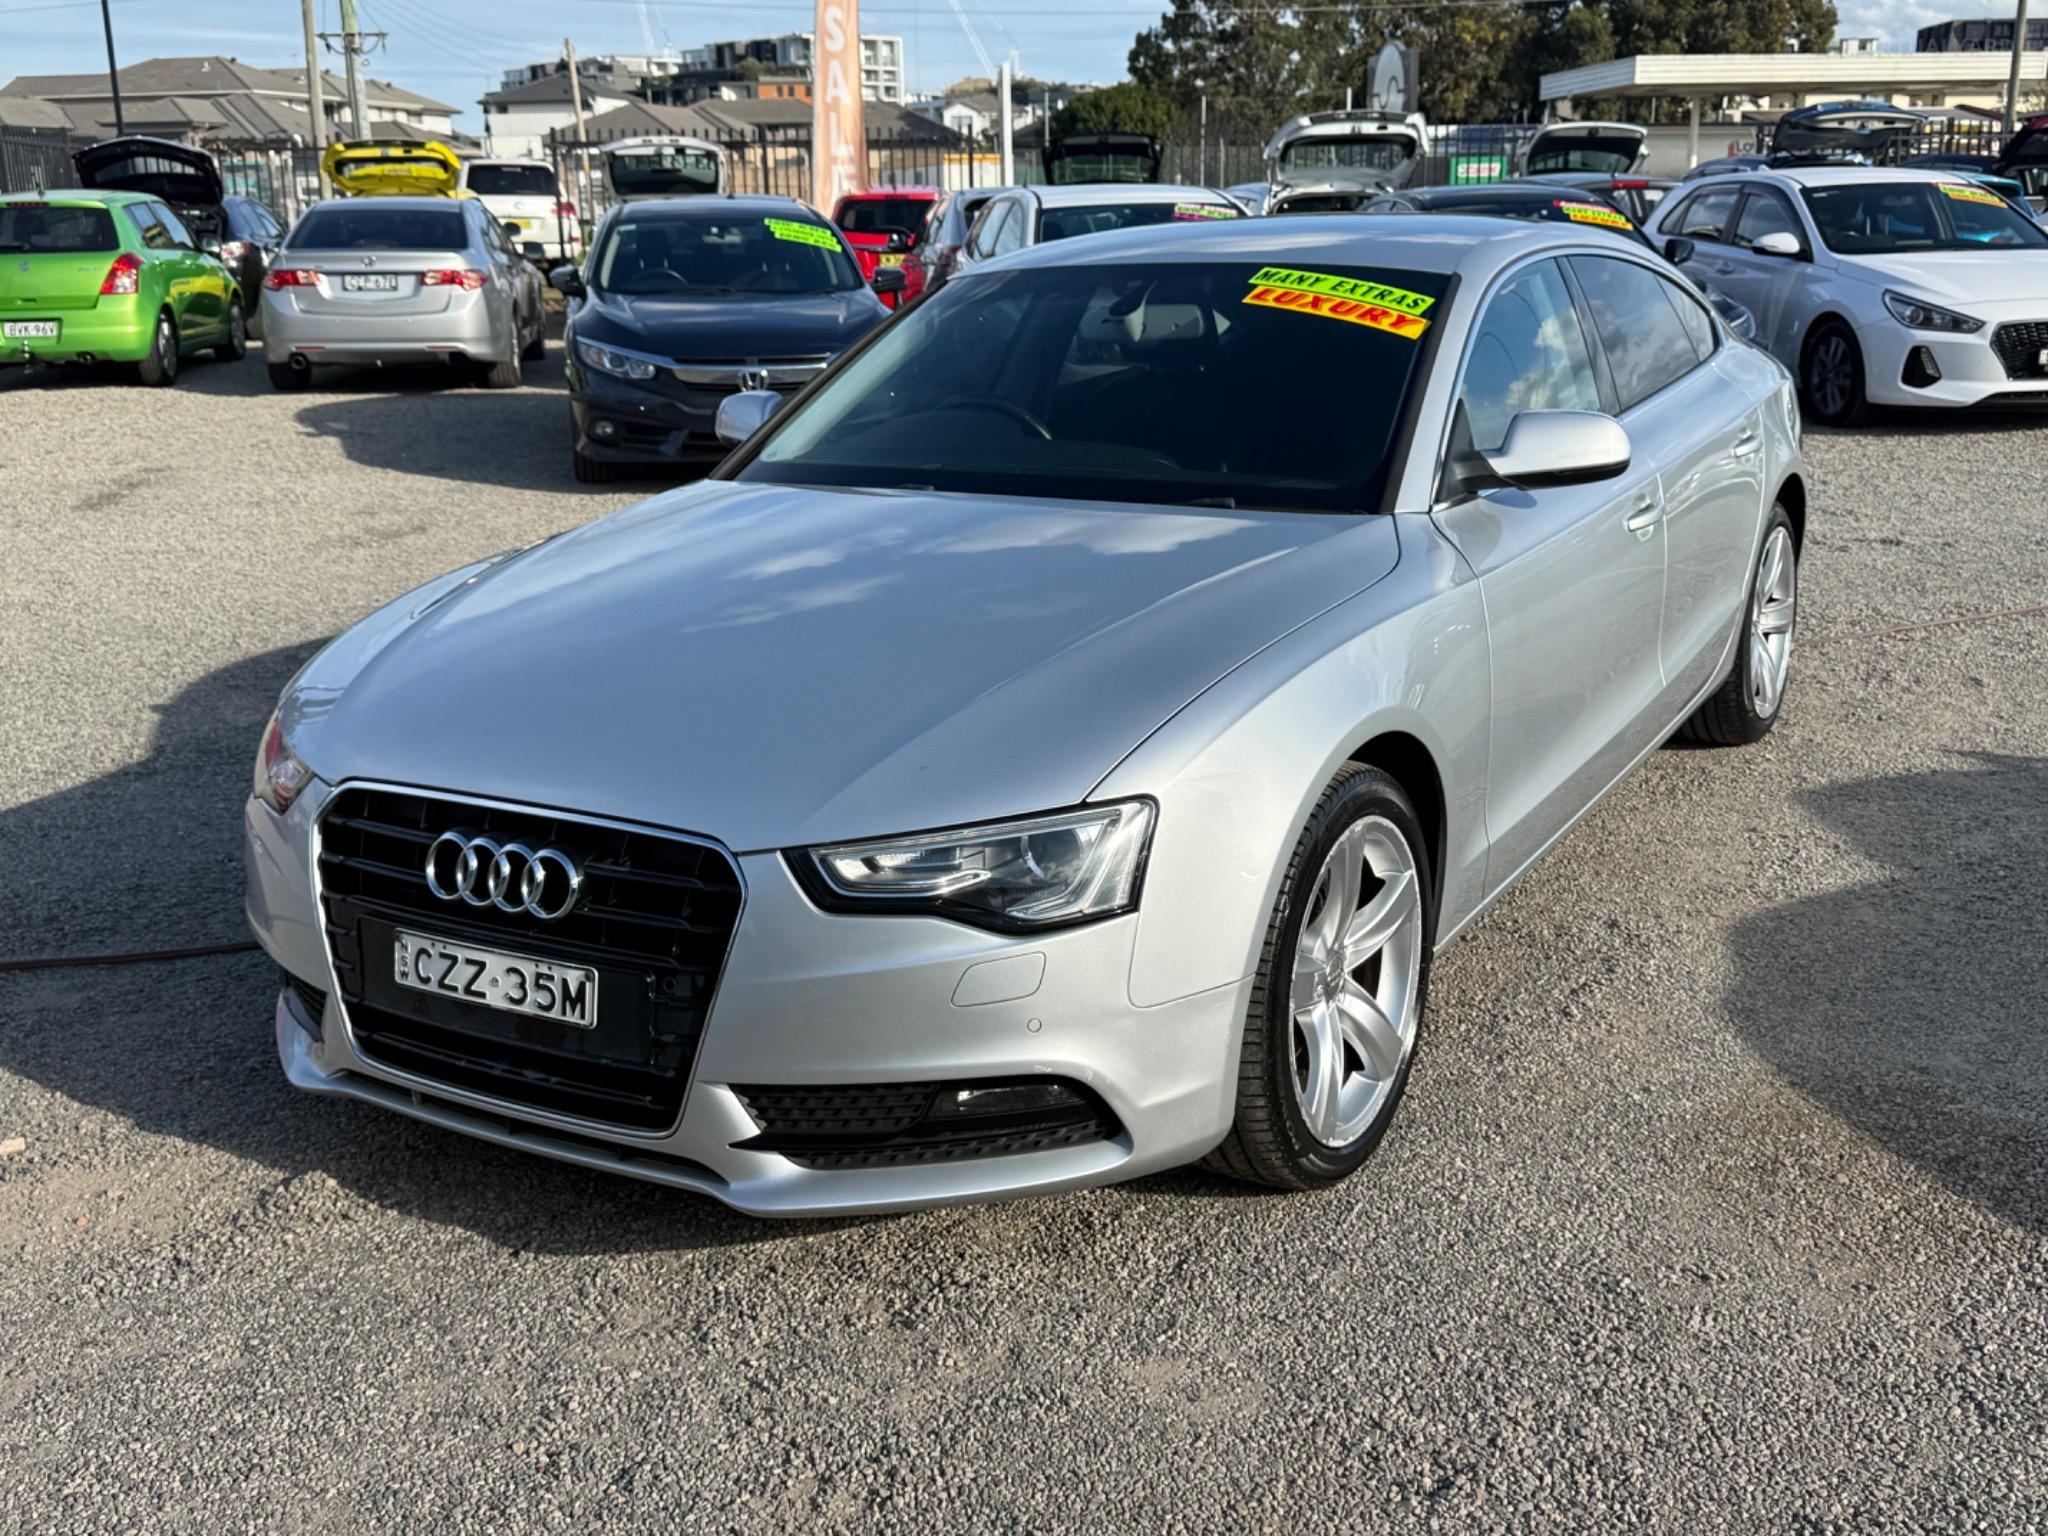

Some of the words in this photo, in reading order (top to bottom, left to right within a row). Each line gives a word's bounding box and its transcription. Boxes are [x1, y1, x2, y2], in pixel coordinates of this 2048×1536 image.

[824, 6, 857, 205] SALE
[1250, 288, 1423, 329] LUXURY
[1255, 270, 1329, 288] MANY
[1329, 280, 1426, 309] EXTRAS
[415, 947, 487, 999] CZZ
[505, 966, 587, 1020] 35M
